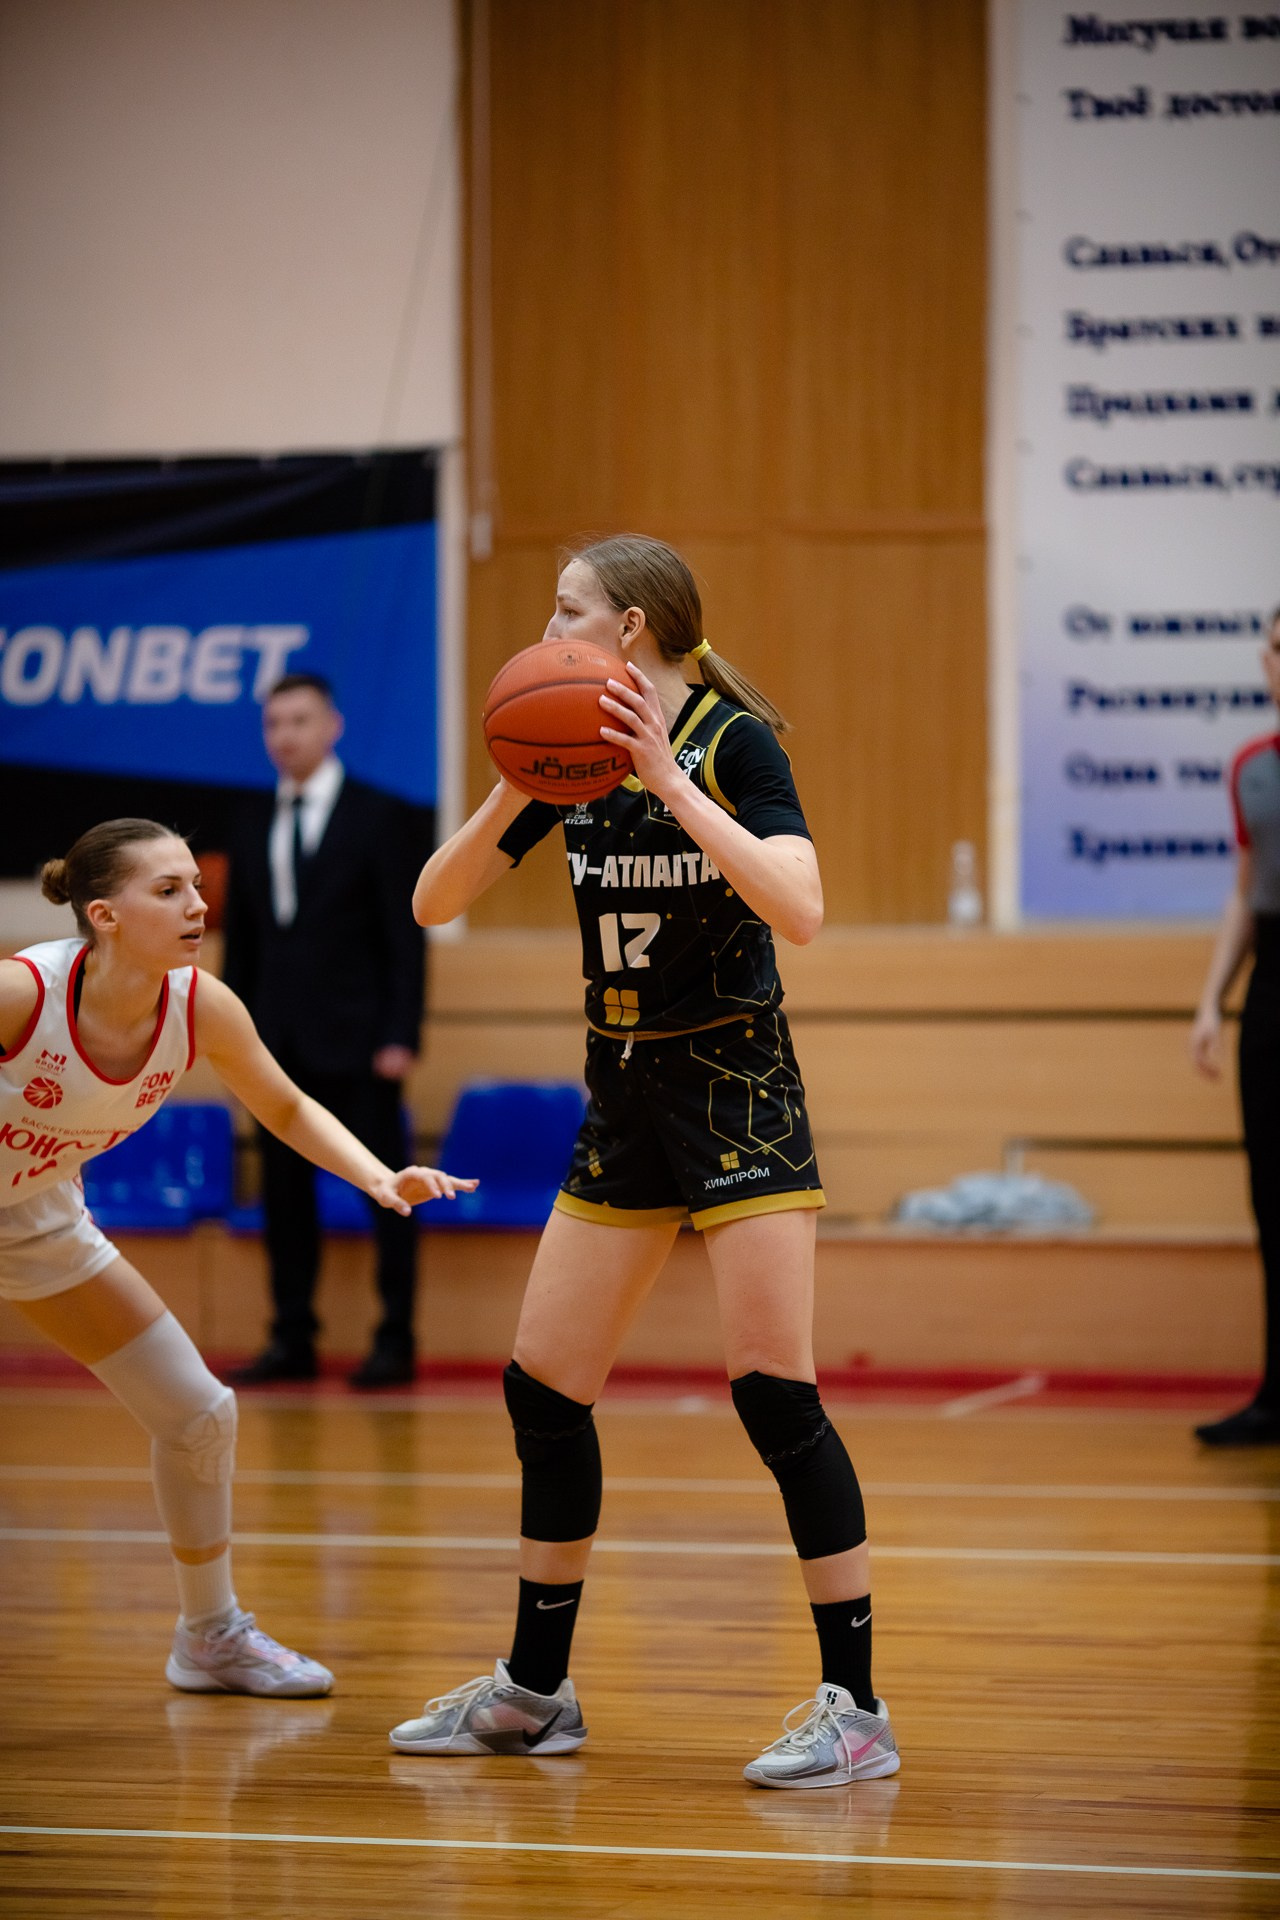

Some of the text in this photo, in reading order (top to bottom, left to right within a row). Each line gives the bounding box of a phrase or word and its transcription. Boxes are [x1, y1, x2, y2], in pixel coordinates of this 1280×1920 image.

[0, 624, 310, 706] ONBET
[520, 756, 628, 780] JÖGEL
[598, 912, 661, 973] 12
[703, 1167, 770, 1191] ХИМПРОМ
